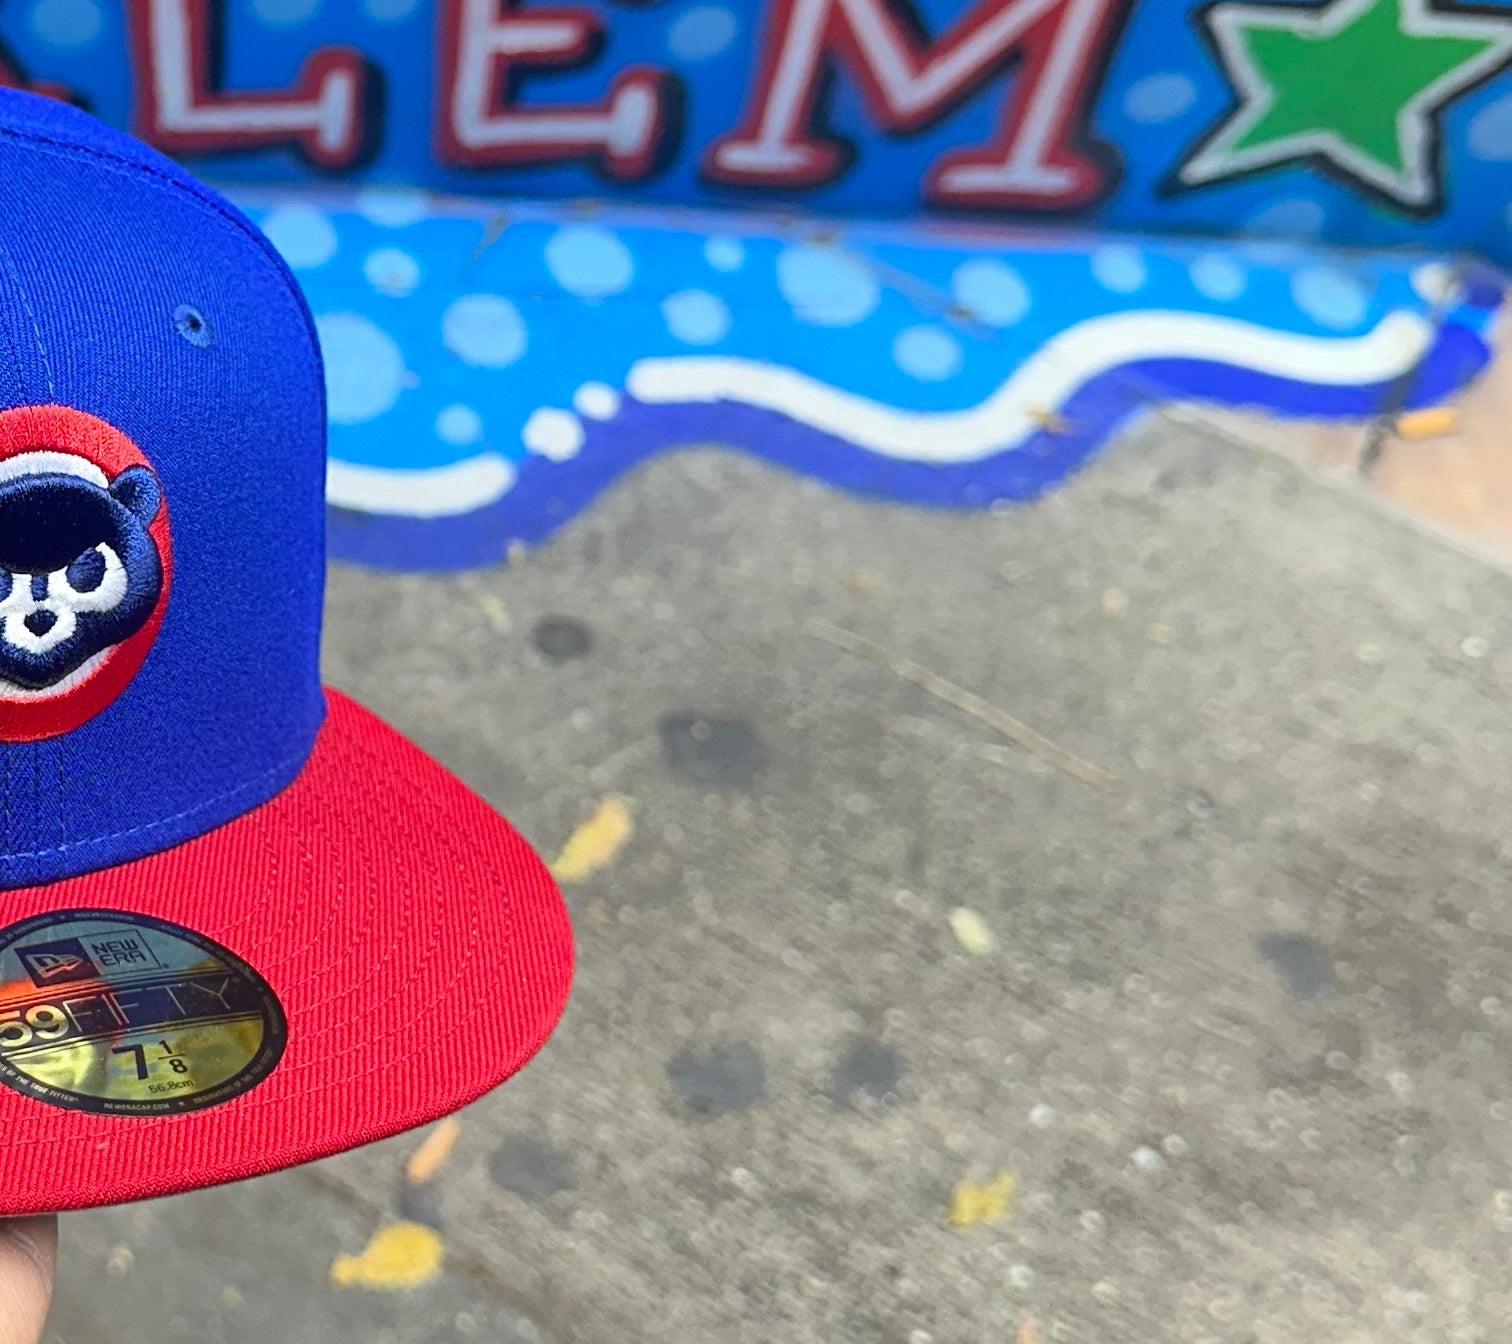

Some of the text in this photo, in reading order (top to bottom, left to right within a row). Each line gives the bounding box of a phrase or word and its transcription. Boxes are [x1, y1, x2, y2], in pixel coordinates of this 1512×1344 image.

[90, 937, 139, 956] NEW
[99, 951, 148, 967] ERA
[112, 1043, 149, 1080] 7
